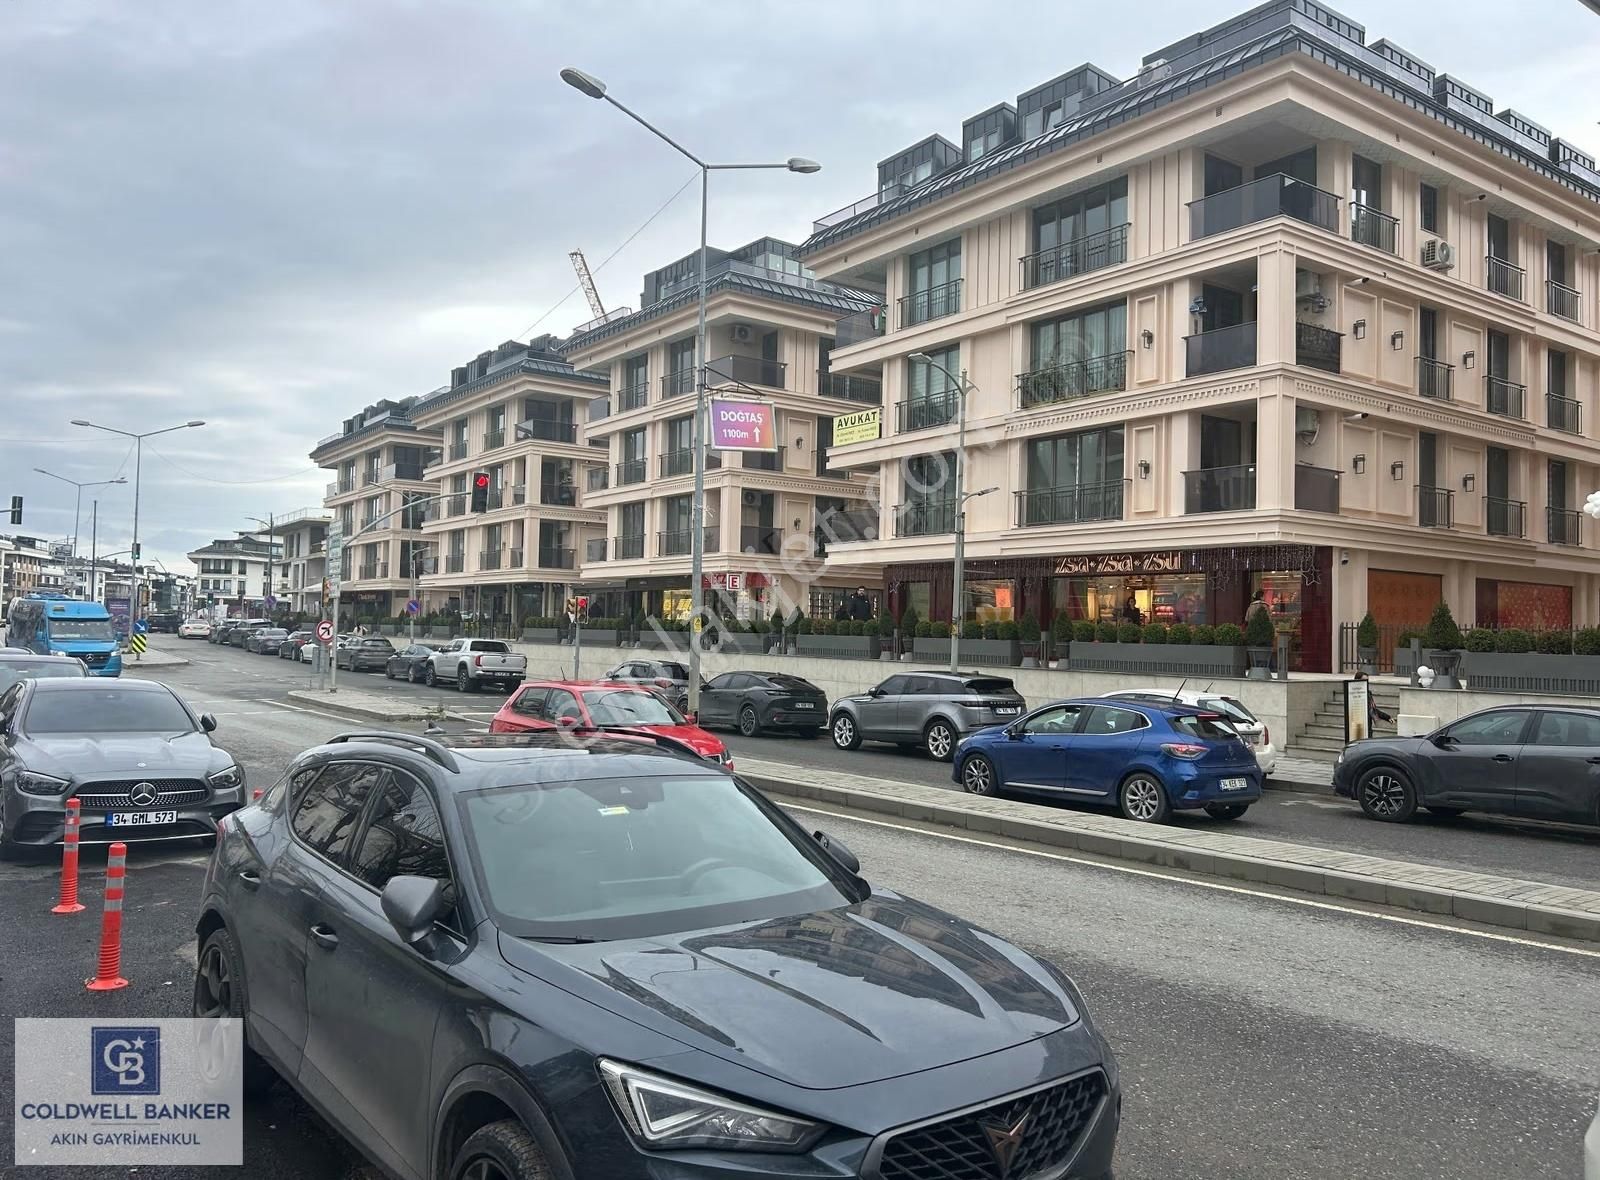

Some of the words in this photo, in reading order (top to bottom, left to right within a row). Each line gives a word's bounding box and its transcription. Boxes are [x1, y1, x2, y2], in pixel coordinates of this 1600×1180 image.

[837, 411, 877, 428] AVUKAT
[722, 428, 749, 439] 1100m
[114, 814, 127, 825] 34
[131, 813, 151, 824] GML
[155, 811, 174, 823] 573
